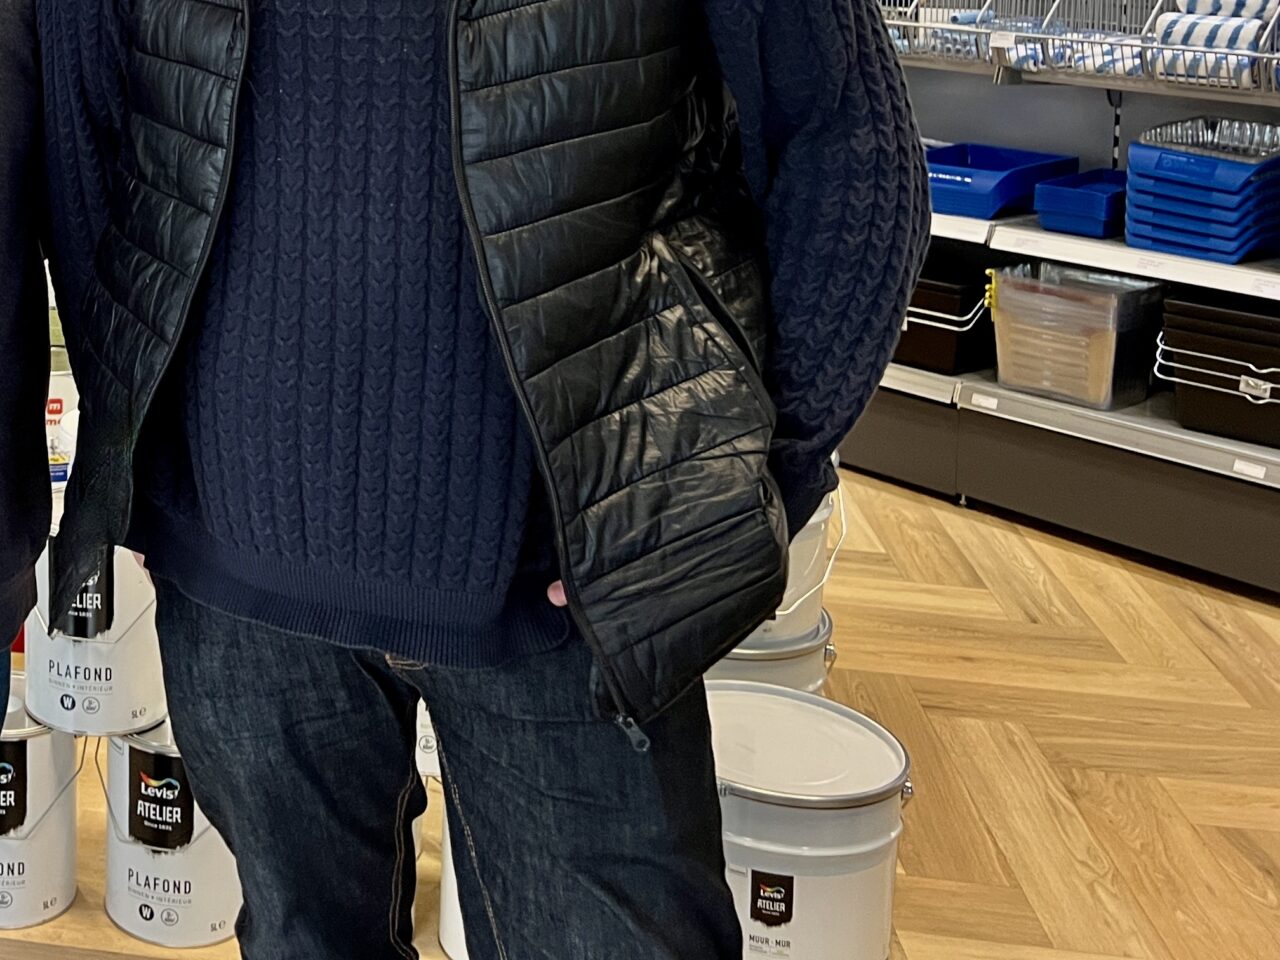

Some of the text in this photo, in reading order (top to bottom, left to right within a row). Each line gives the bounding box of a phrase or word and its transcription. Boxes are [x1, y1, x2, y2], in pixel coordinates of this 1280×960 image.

[72, 593, 102, 610] LIER
[48, 659, 113, 682] PLAFOND
[137, 800, 182, 823] ATELIER
[128, 868, 191, 894] PLAFOND
[757, 899, 786, 913] ATELIER
